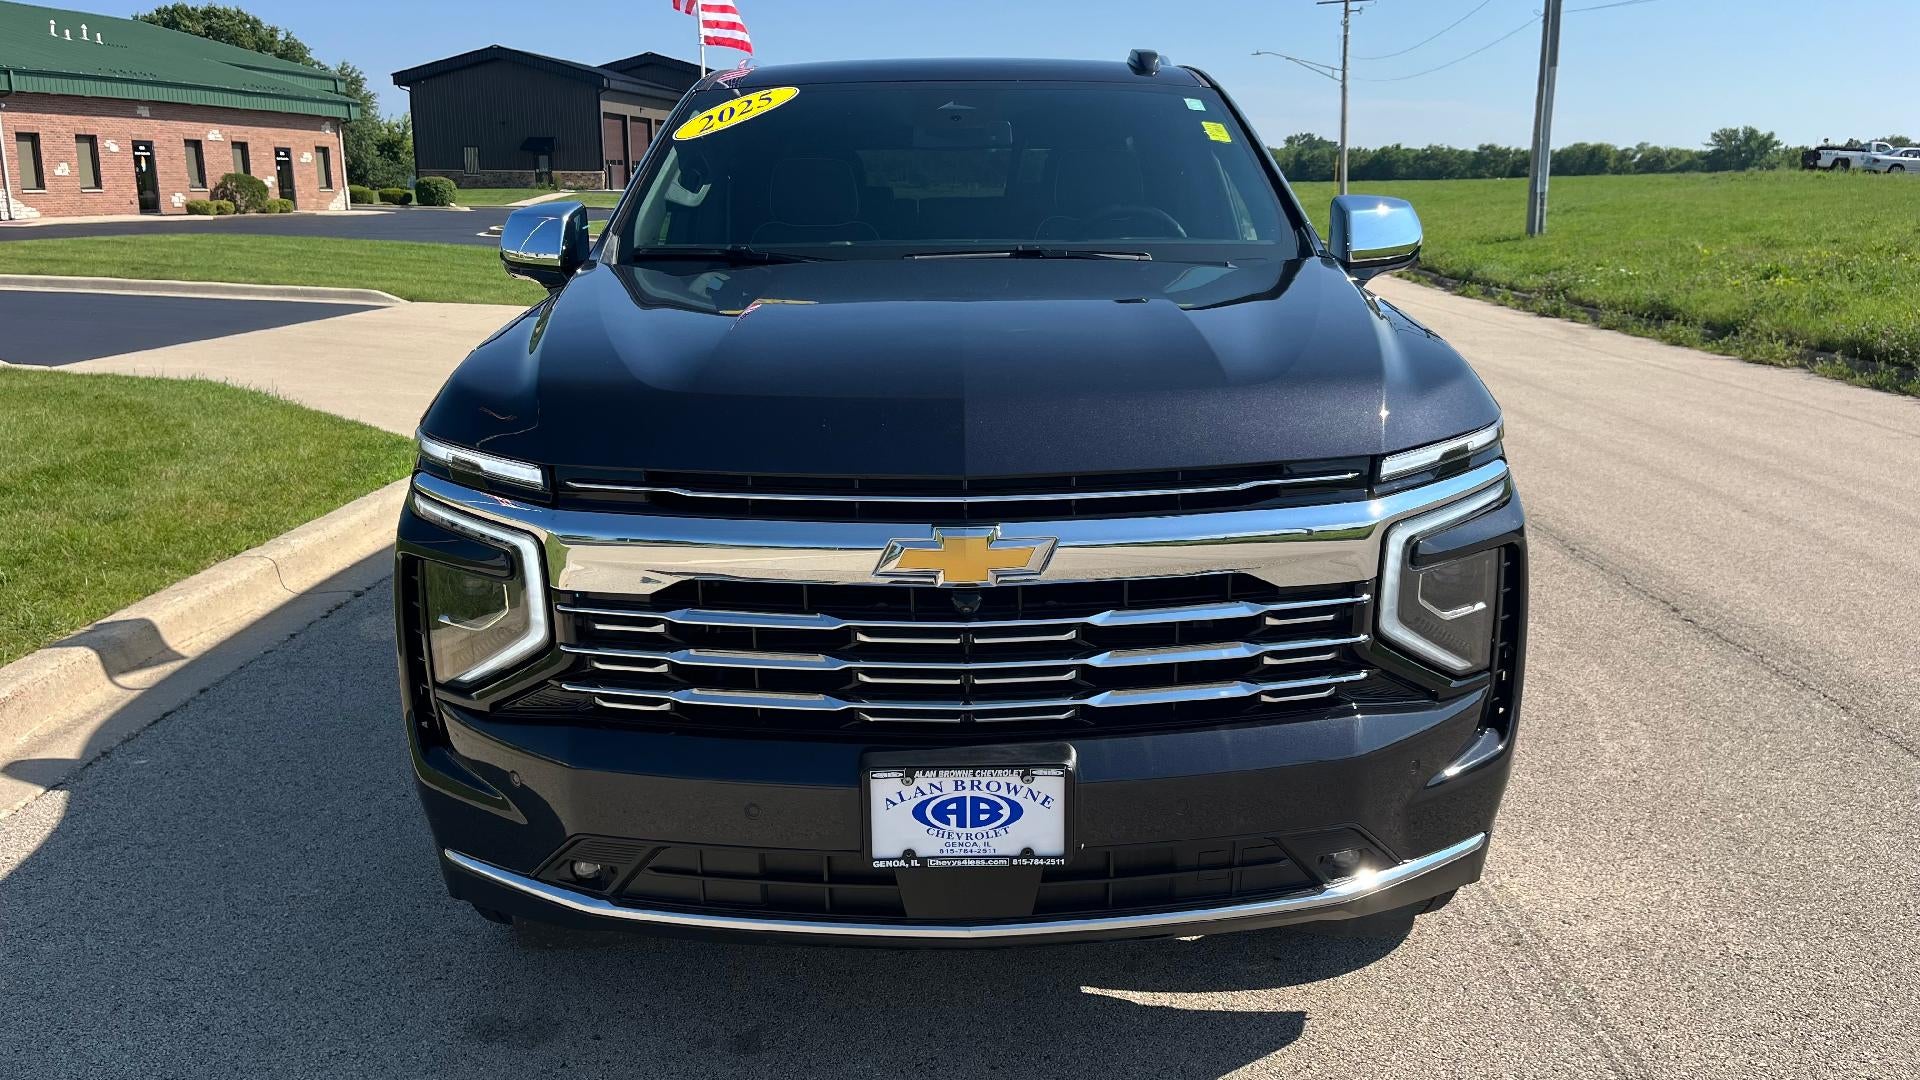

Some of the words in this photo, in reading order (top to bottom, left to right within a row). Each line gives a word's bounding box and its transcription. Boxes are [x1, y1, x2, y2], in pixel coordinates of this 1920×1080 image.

[698, 91, 773, 133] 2025
[914, 770, 937, 778] ALAN
[938, 769, 973, 778] BROWNE
[975, 769, 1025, 777] CHEVROLET
[884, 781, 944, 811] ALAN
[953, 779, 1055, 810] BROWNE
[926, 826, 1010, 841] CHEVROLET
[872, 860, 909, 868] GENOA,
[929, 859, 1008, 867] Chevys4less.com
[1012, 858, 1065, 866] 815-784-2511
